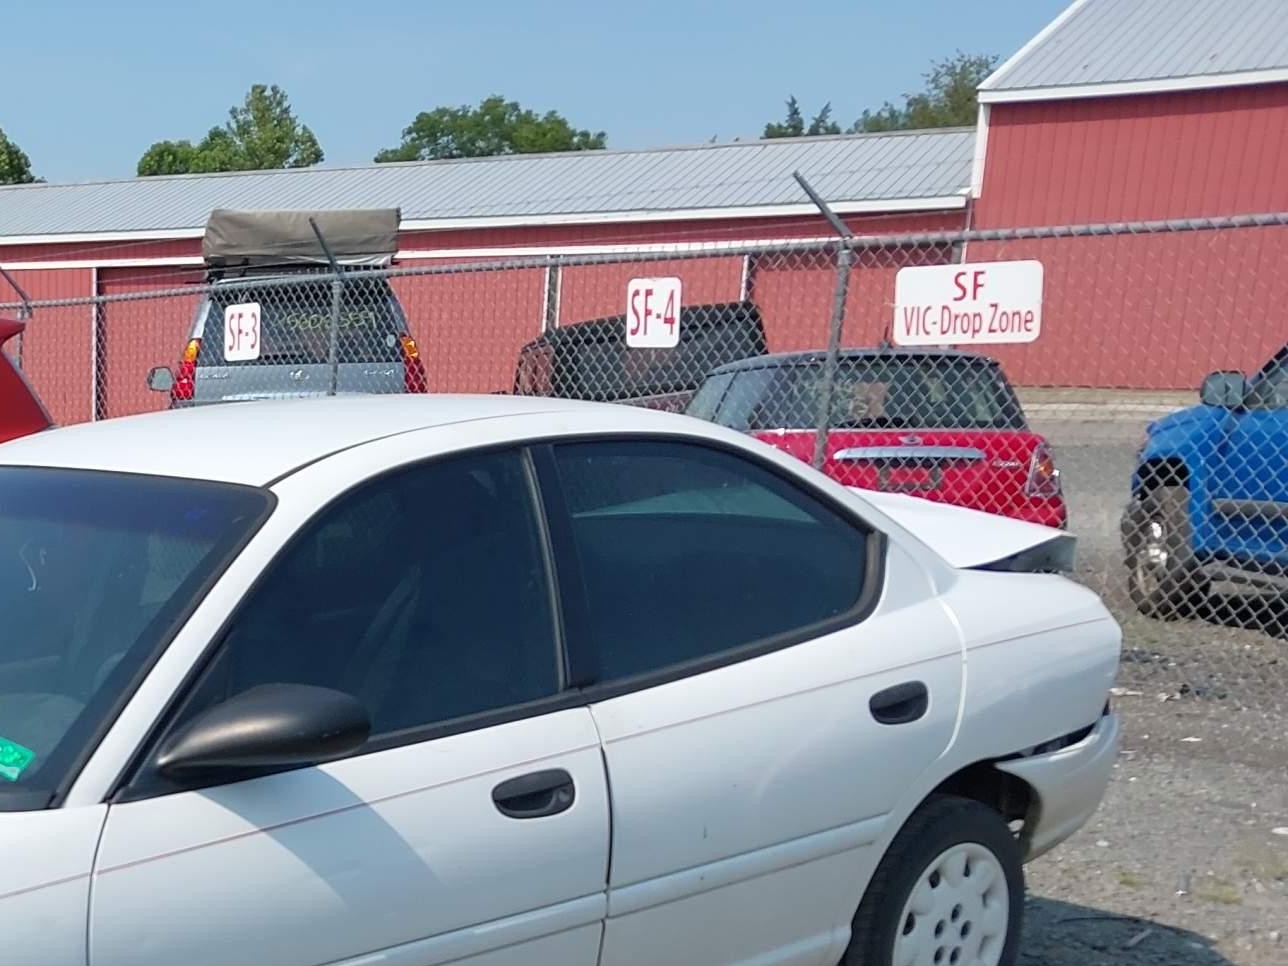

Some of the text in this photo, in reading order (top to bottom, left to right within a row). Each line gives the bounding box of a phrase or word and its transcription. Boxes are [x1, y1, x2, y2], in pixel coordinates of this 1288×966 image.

[953, 270, 986, 301] SF
[630, 288, 676, 336] SF-4
[903, 303, 1034, 339] VIC-Drop Zone
[228, 312, 258, 351] SF-3
